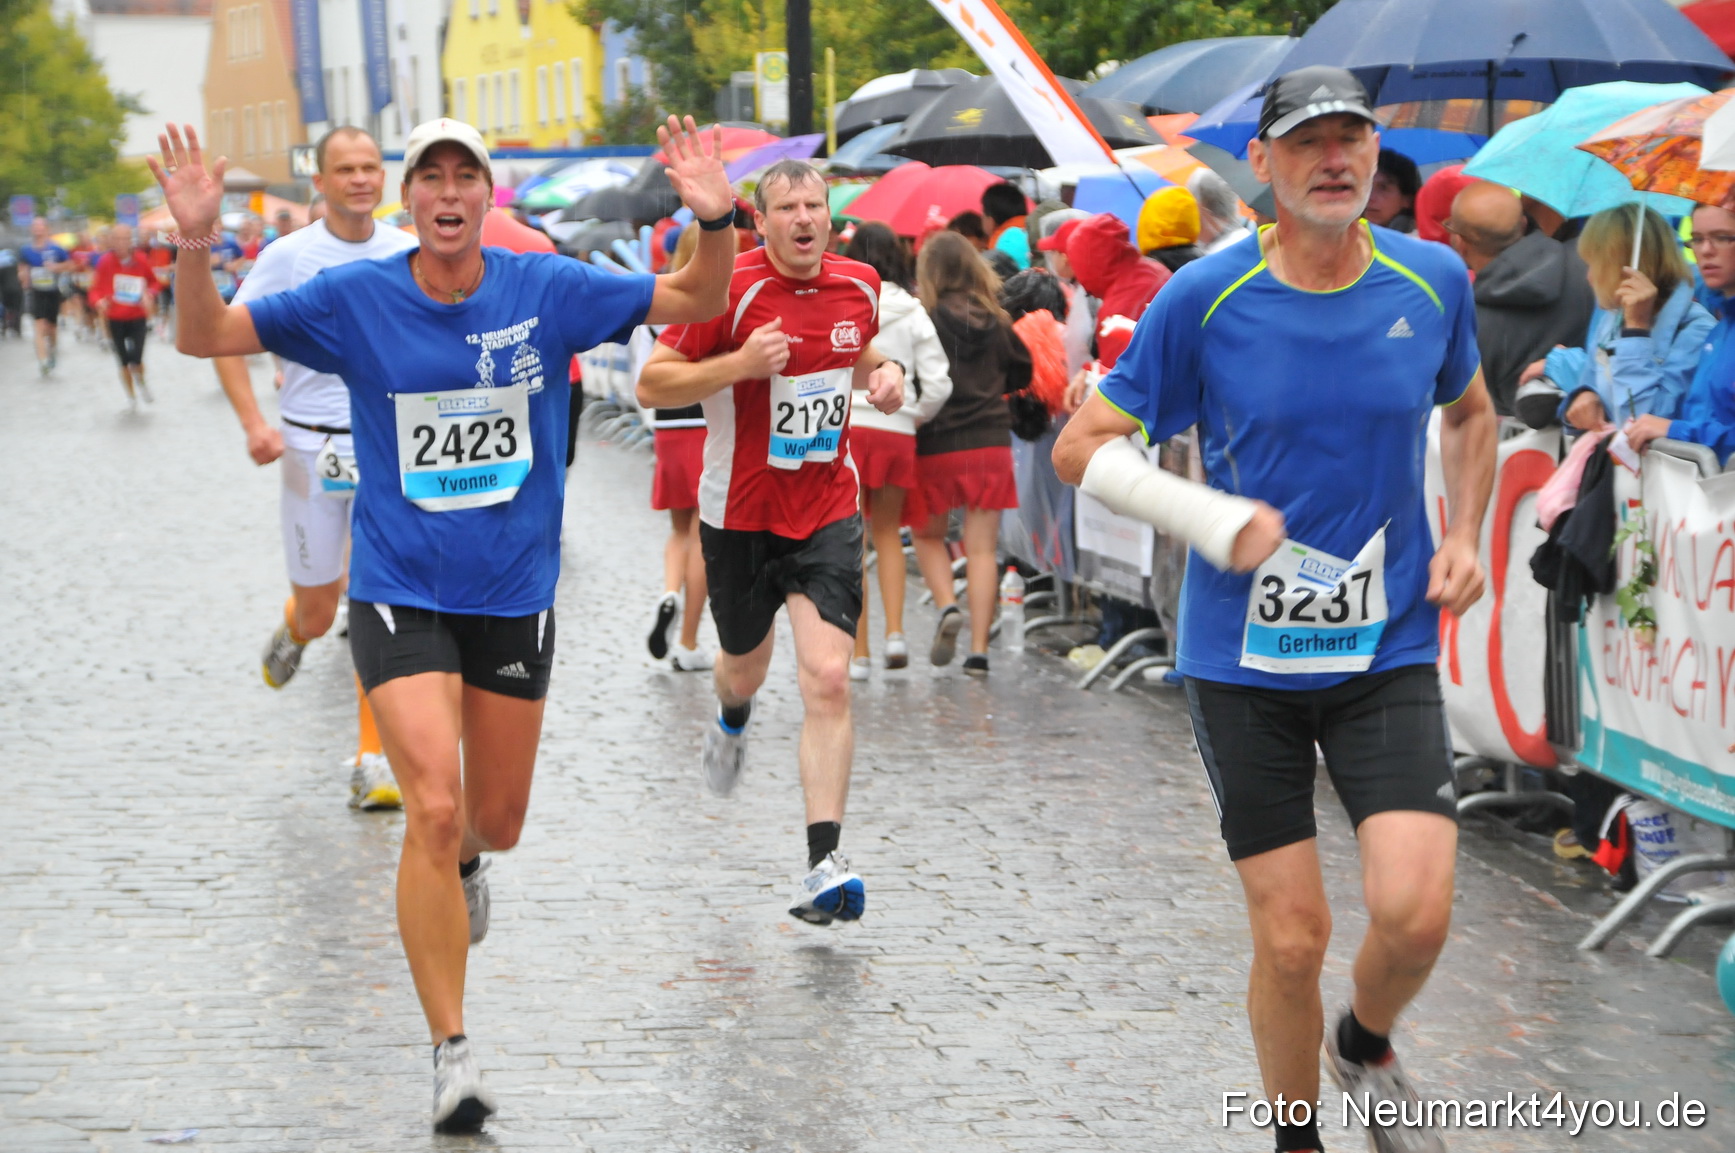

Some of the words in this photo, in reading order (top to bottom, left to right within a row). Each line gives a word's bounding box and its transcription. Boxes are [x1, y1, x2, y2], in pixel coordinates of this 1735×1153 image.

[481, 316, 539, 341] NEUMARKTER
[481, 328, 530, 351] STADTLAUF
[437, 396, 490, 411] BOCK
[776, 394, 846, 434] 2128
[412, 417, 518, 466] 2423
[437, 473, 499, 493] Yvonne
[1258, 569, 1373, 623] 3237
[1278, 633, 1358, 654] Gerhard
